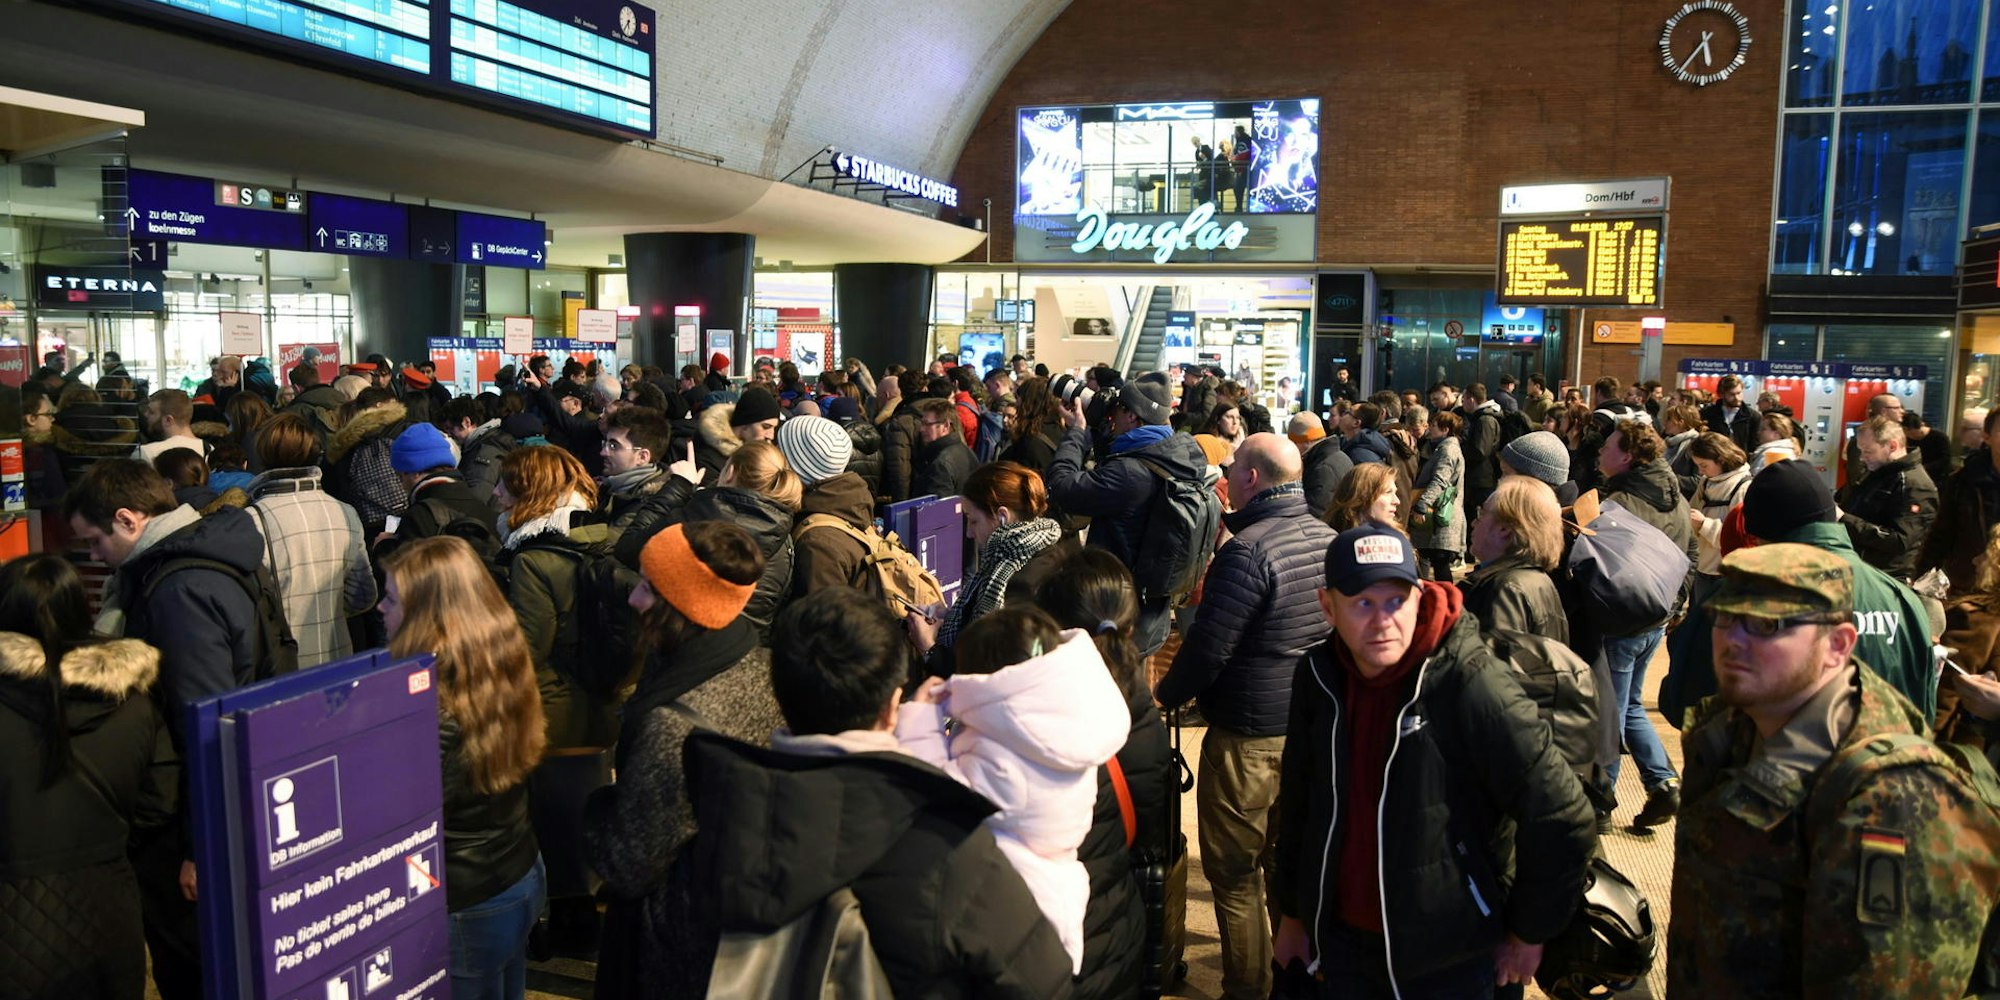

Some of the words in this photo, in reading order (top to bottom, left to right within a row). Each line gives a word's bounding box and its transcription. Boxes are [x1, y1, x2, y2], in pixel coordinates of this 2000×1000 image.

[851, 155, 921, 196] STARBUCKS
[921, 178, 958, 207] COFFEE
[1585, 191, 1635, 203] Dom/Hbf
[149, 211, 160, 220] zu
[161, 209, 177, 221] den
[179, 210, 205, 224] Zügen
[149, 223, 196, 236] koelnmesse
[1071, 202, 1249, 265] Douglas
[47, 276, 157, 293] ETERNA
[1691, 361, 1725, 369] Fahrkarten
[1770, 363, 1804, 371] Fahrkarten
[411, 672, 430, 690] DB
[271, 849, 288, 865] DB
[289, 827, 343, 860] Information
[271, 887, 302, 914] Hier
[304, 874, 334, 898] kein
[335, 821, 438, 884] Fahrkartenverkauf
[274, 932, 296, 954] No
[298, 914, 331, 942] ticket
[332, 903, 364, 924] sales
[365, 887, 391, 909] here
[275, 951, 303, 974] Pas
[305, 940, 322, 957] de
[324, 925, 356, 948] vente
[358, 914, 374, 931] de
[375, 896, 406, 917] billets
